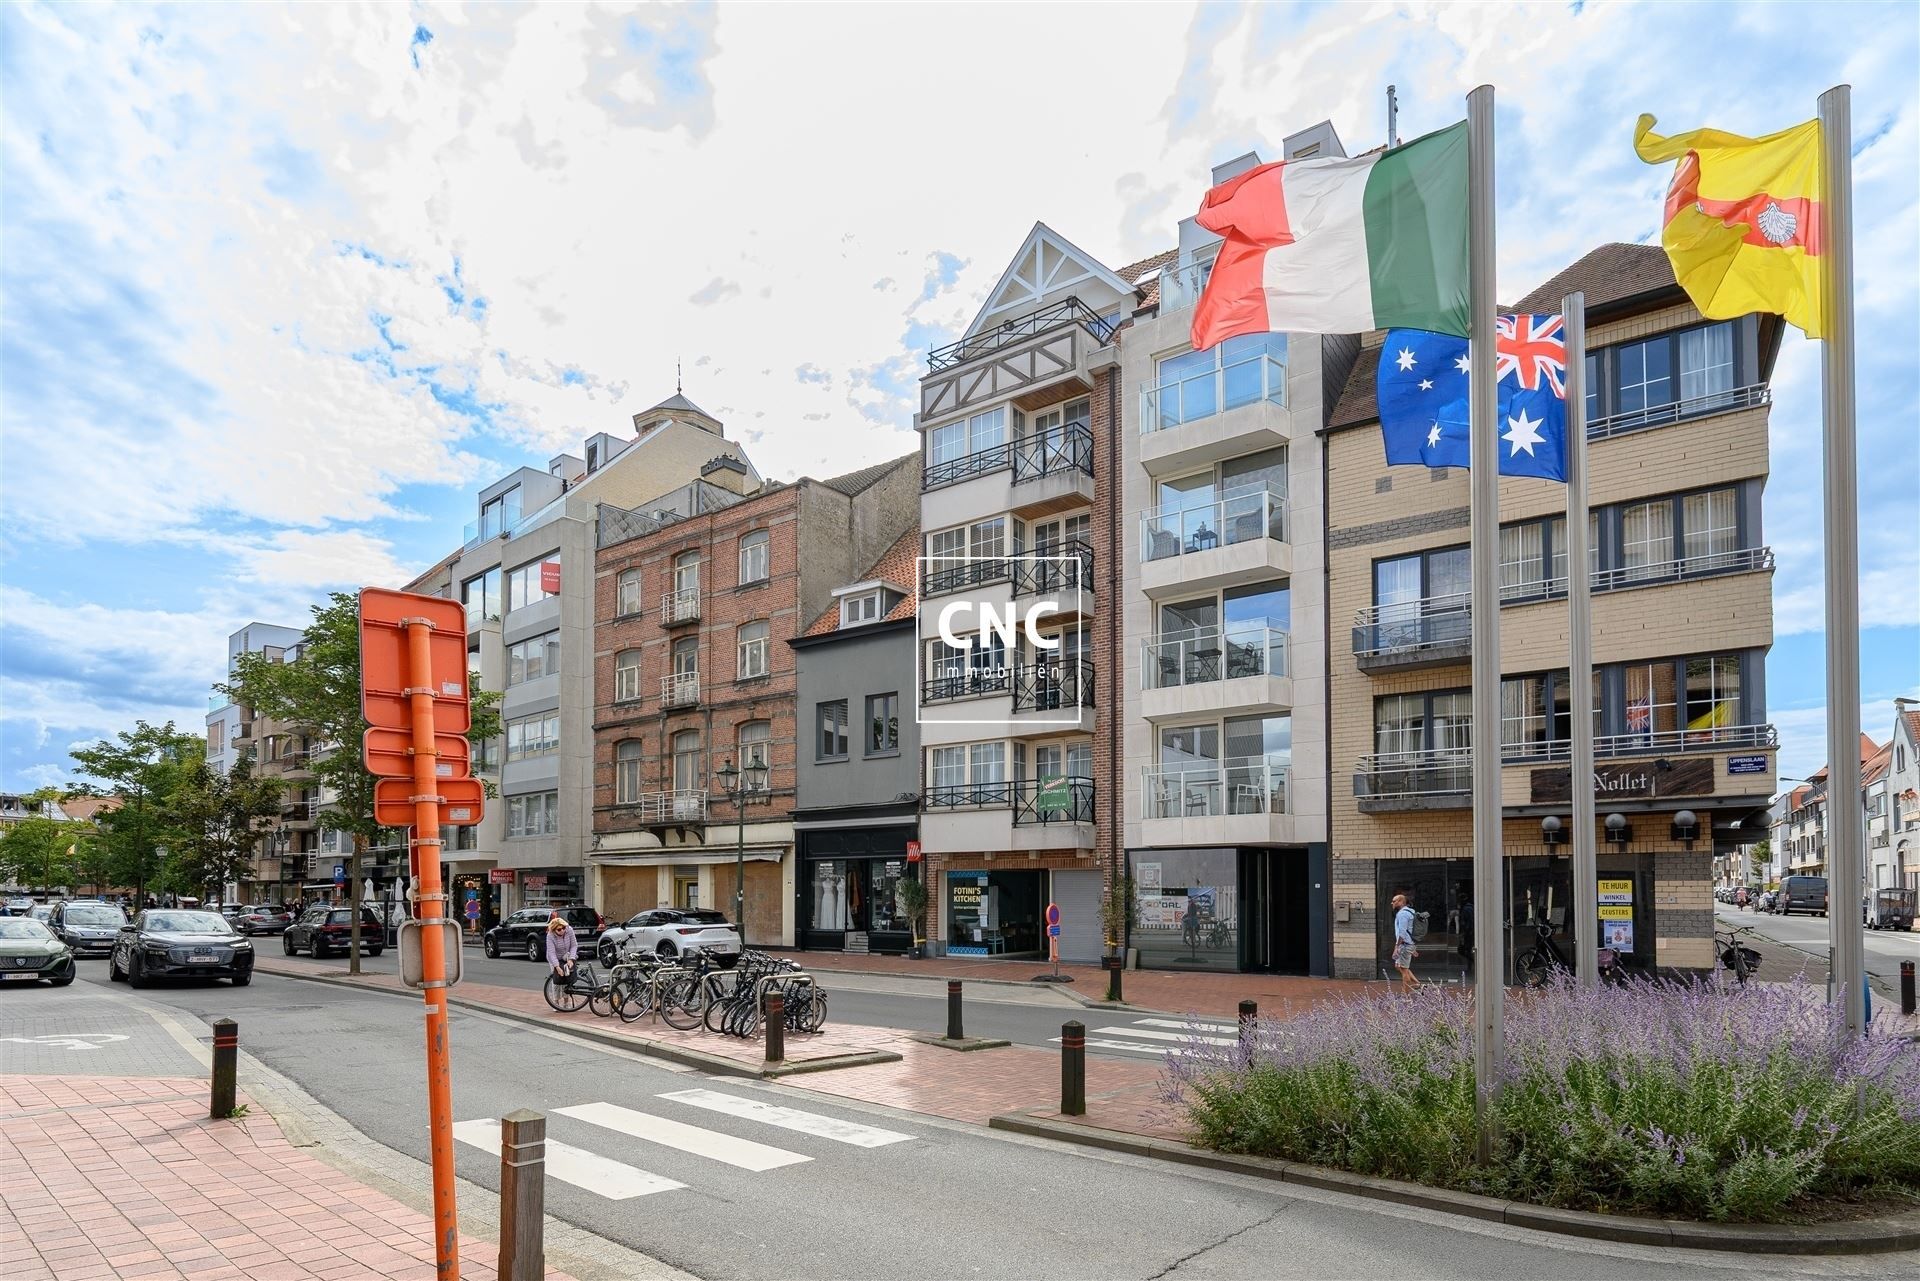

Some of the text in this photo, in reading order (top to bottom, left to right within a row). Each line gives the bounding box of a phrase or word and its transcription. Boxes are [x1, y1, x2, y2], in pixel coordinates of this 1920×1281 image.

[1593, 772, 1648, 791] Nollet
[908, 844, 921, 859] illy
[335, 867, 343, 877] P
[953, 887, 981, 895] FOTINI'S
[953, 895, 981, 903] KITCHEN
